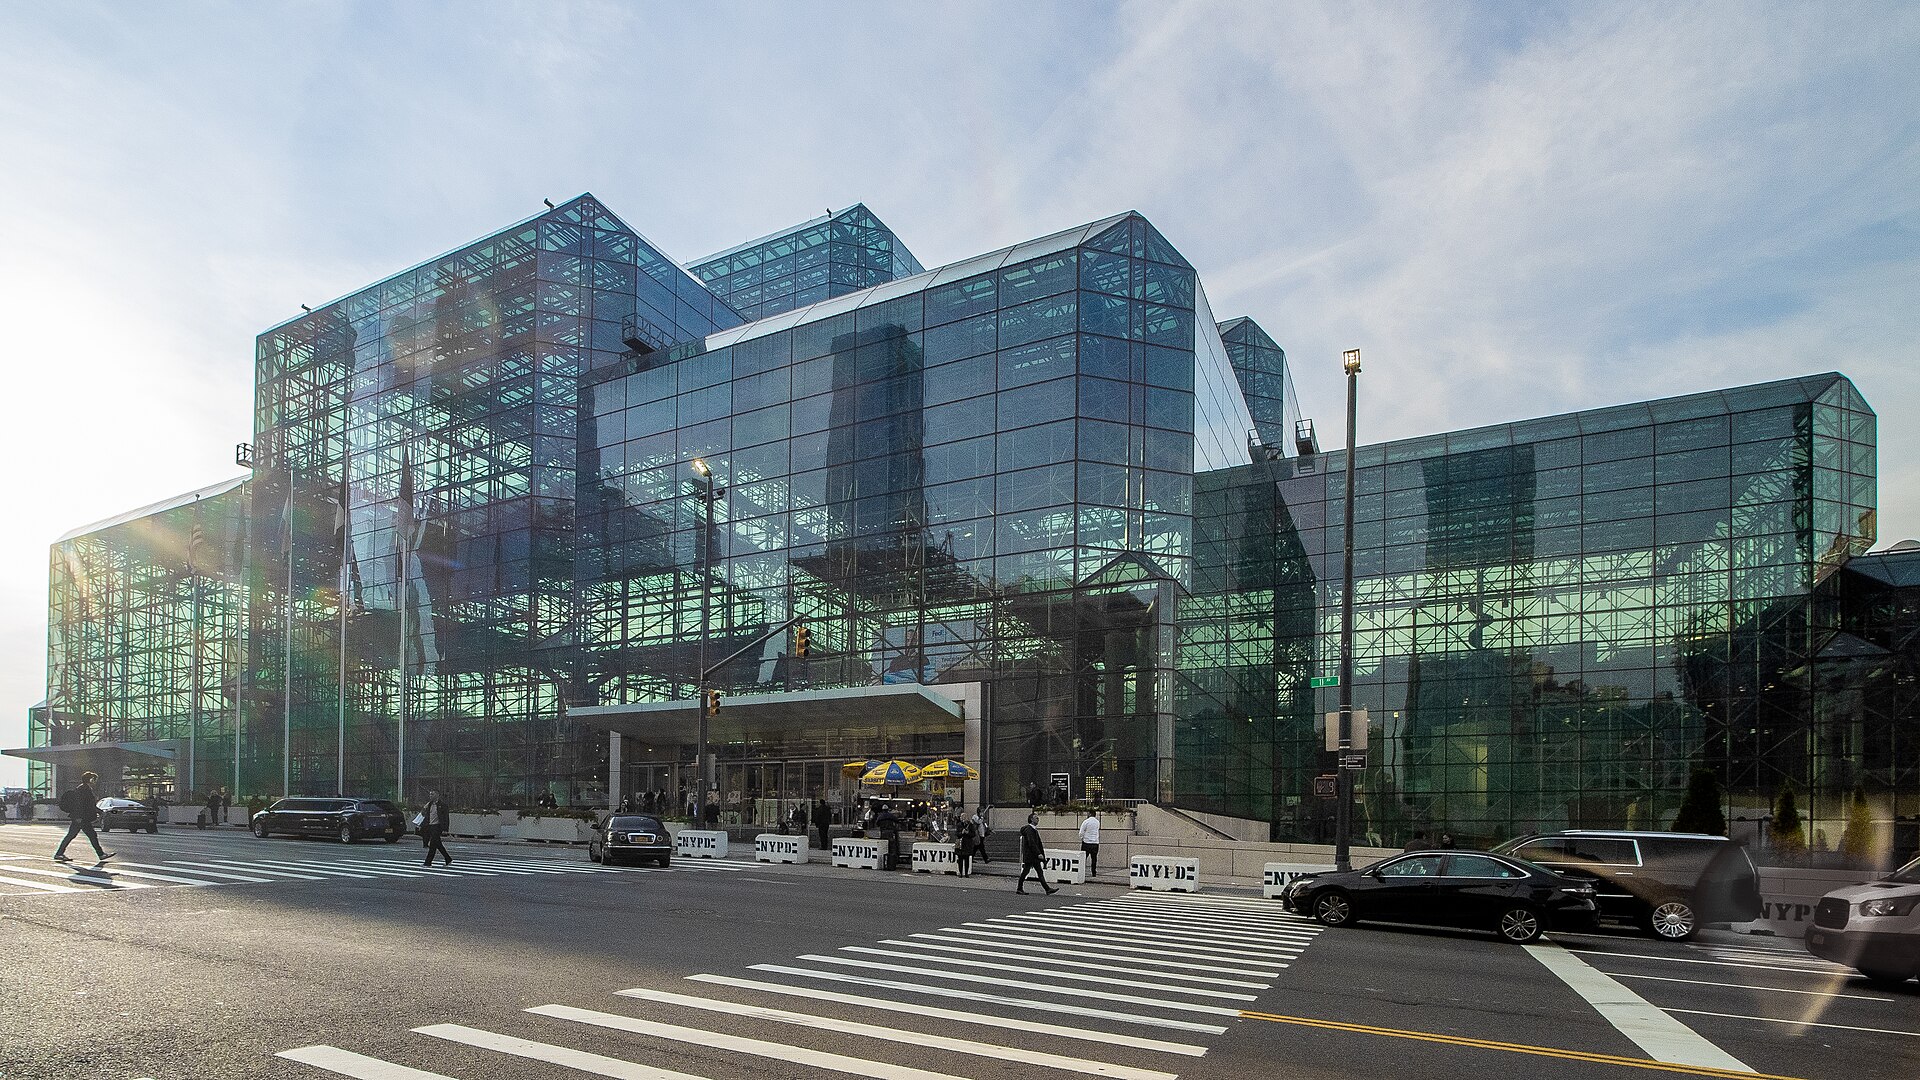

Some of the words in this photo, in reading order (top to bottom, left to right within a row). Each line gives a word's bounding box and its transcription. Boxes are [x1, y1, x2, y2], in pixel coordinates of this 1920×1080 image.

[1319, 678, 1324, 686] 11
[682, 836, 711, 849] NYPD
[760, 841, 792, 853] NYPD
[837, 845, 872, 858] NYPD
[1042, 857, 1072, 872] YPD
[1138, 863, 1188, 879] NYPD
[1761, 902, 1817, 921] NYP
